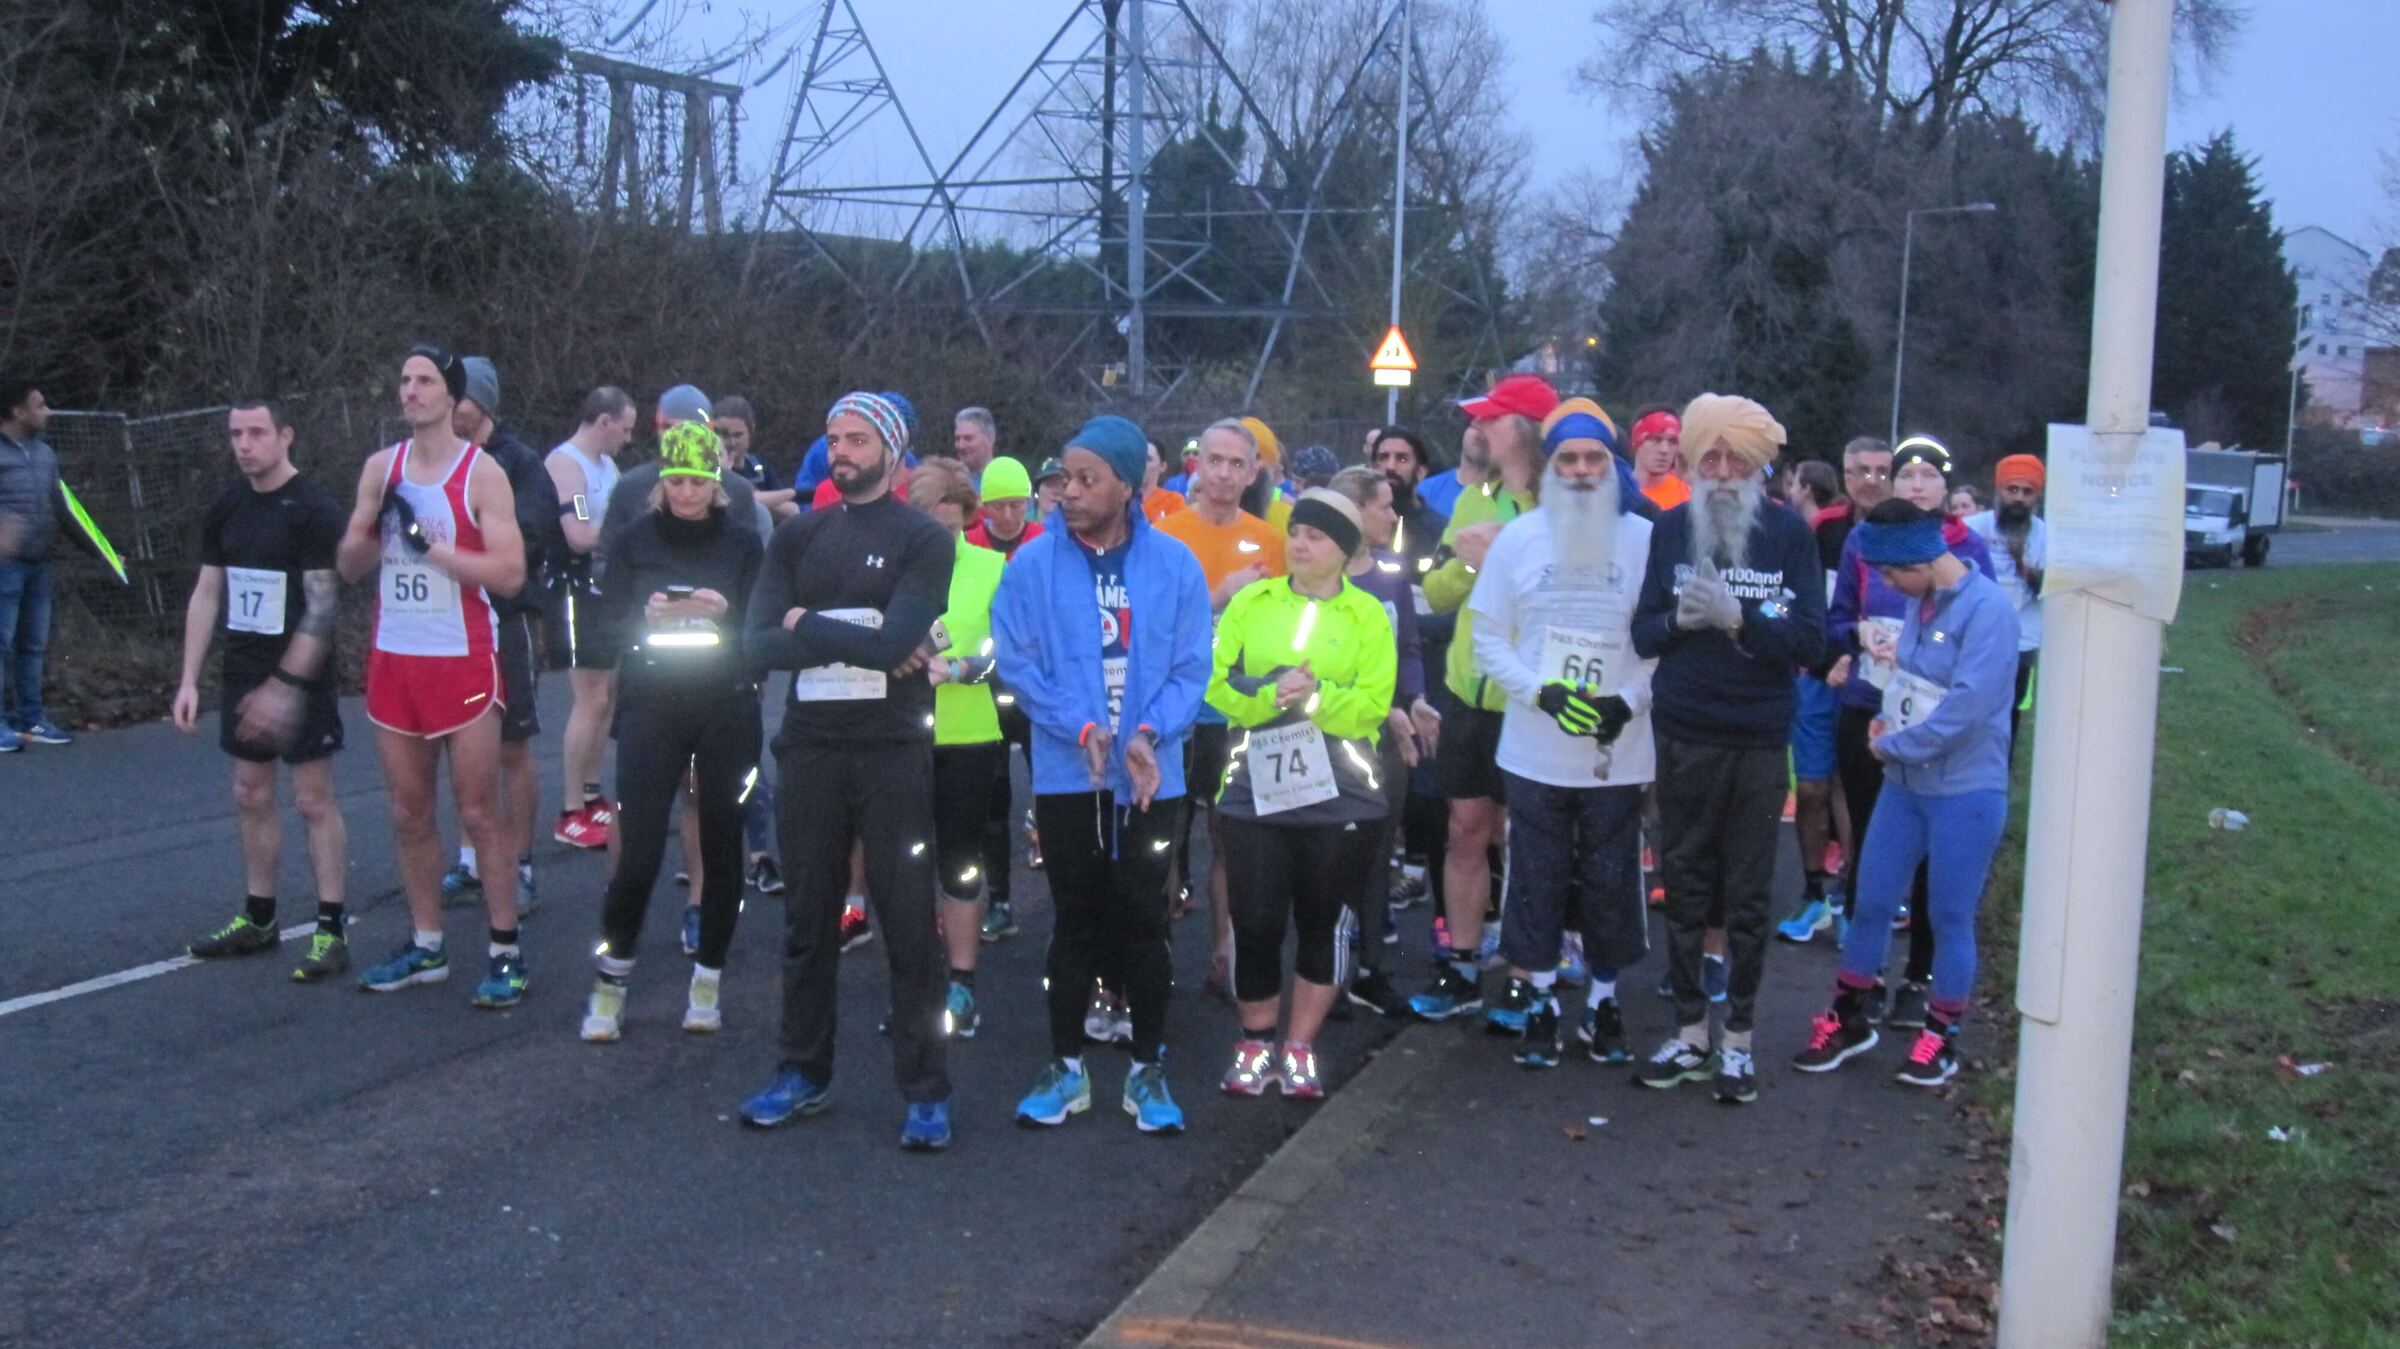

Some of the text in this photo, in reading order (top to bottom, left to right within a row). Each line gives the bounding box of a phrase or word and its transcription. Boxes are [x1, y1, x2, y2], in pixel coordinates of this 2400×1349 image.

[395, 573, 428, 602] 56
[239, 590, 264, 618] 17
[1563, 654, 1605, 684] 66
[1270, 726, 1316, 745] Chemist
[1265, 748, 1309, 783] 74
